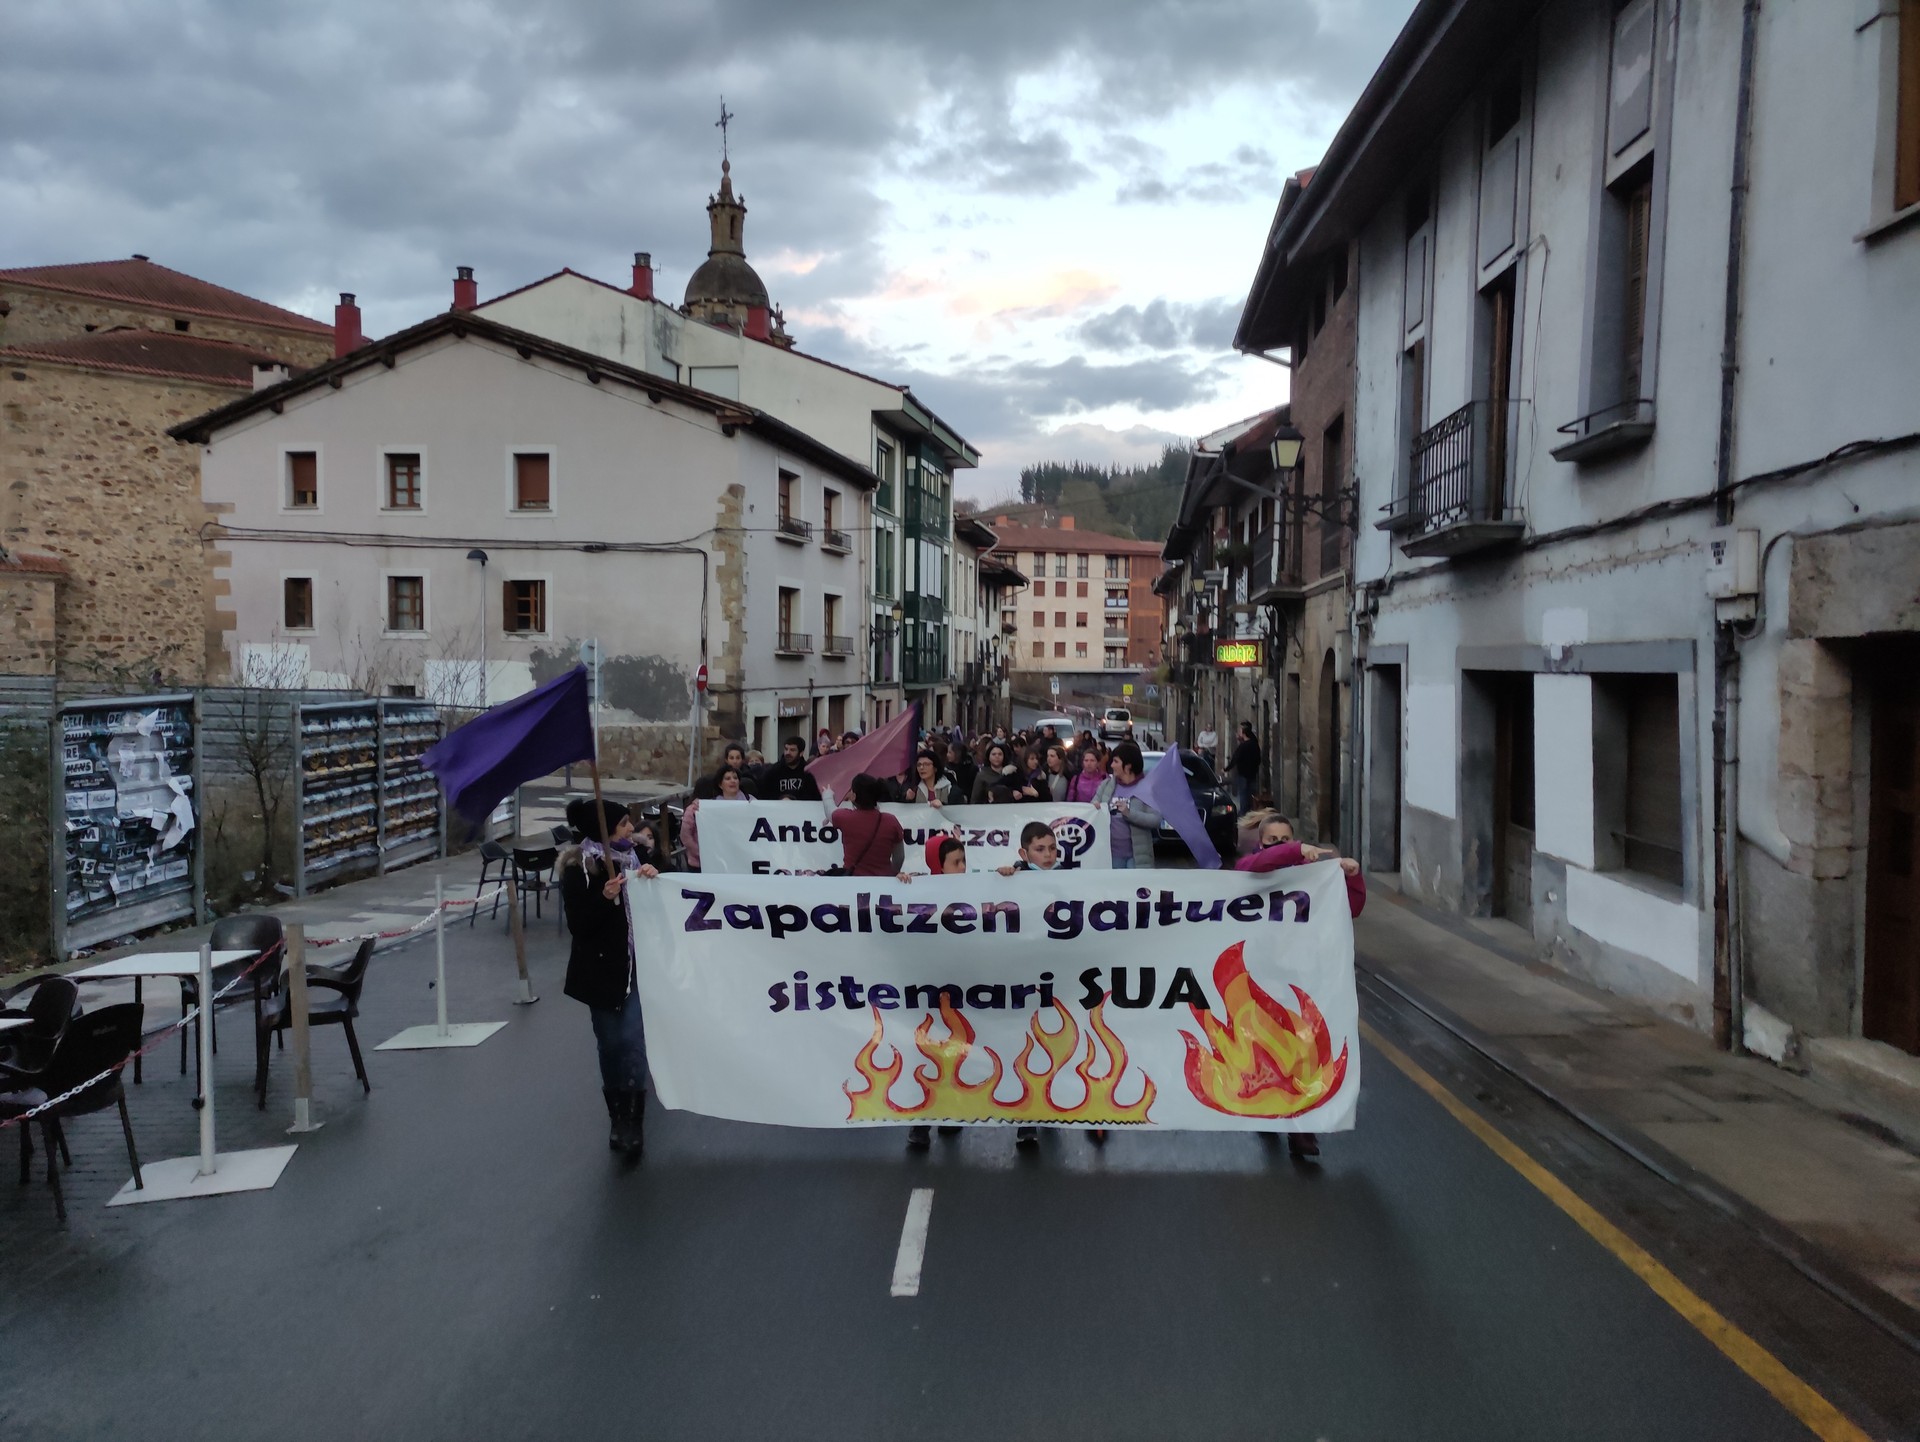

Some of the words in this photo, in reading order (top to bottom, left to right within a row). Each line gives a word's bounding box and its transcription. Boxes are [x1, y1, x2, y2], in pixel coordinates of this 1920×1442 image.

[681, 888, 1021, 939] Zapaltzen
[1043, 887, 1311, 939] gaituen
[767, 970, 1055, 1012] sistemari
[1078, 966, 1211, 1010] SUA
